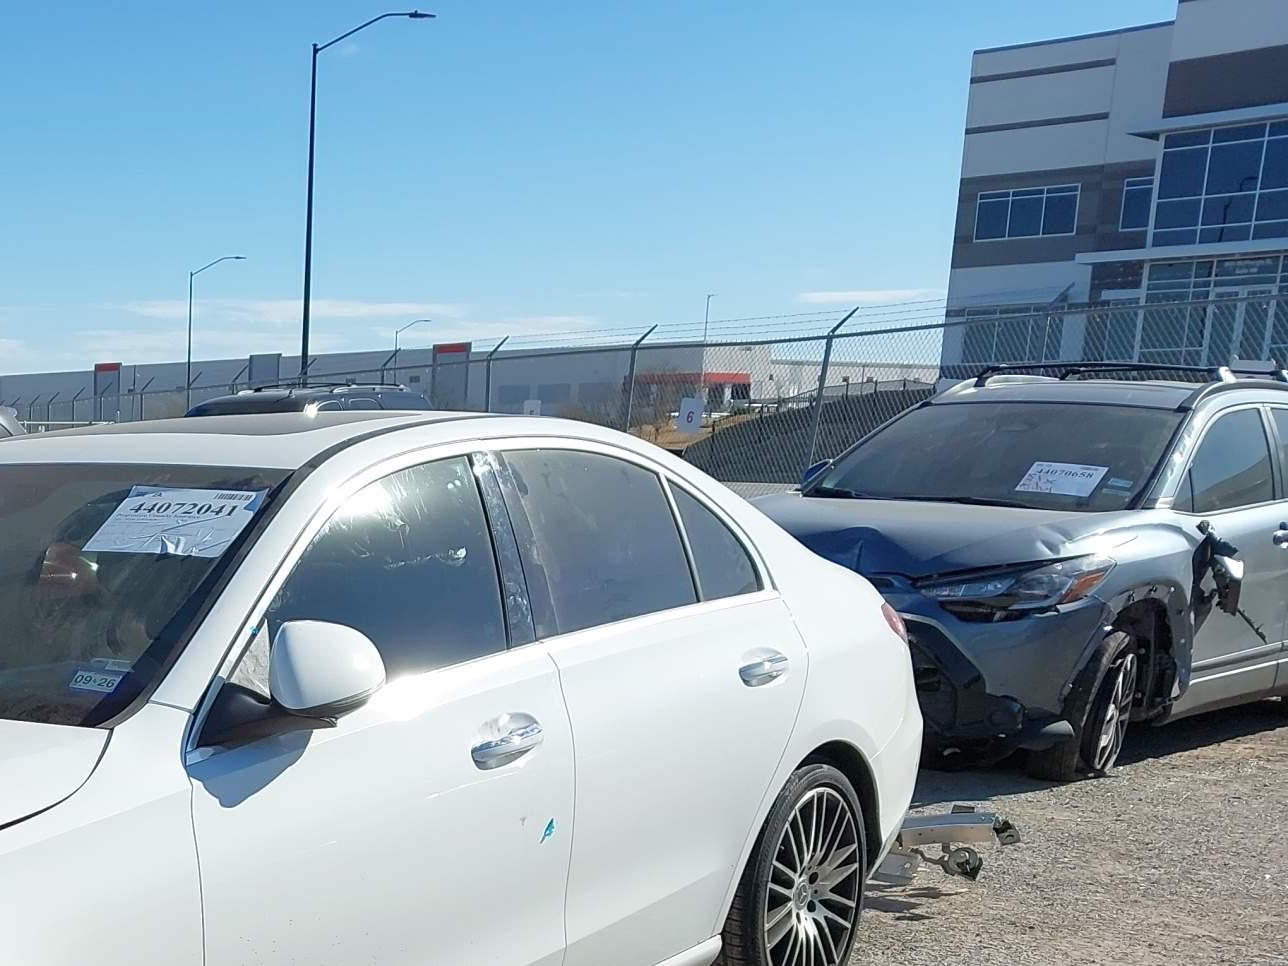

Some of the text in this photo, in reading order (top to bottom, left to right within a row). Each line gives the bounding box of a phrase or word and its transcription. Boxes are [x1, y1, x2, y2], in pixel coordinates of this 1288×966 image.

[686, 410, 695, 424] 6
[129, 501, 240, 517] 44072041
[74, 674, 116, 688] 09 26
